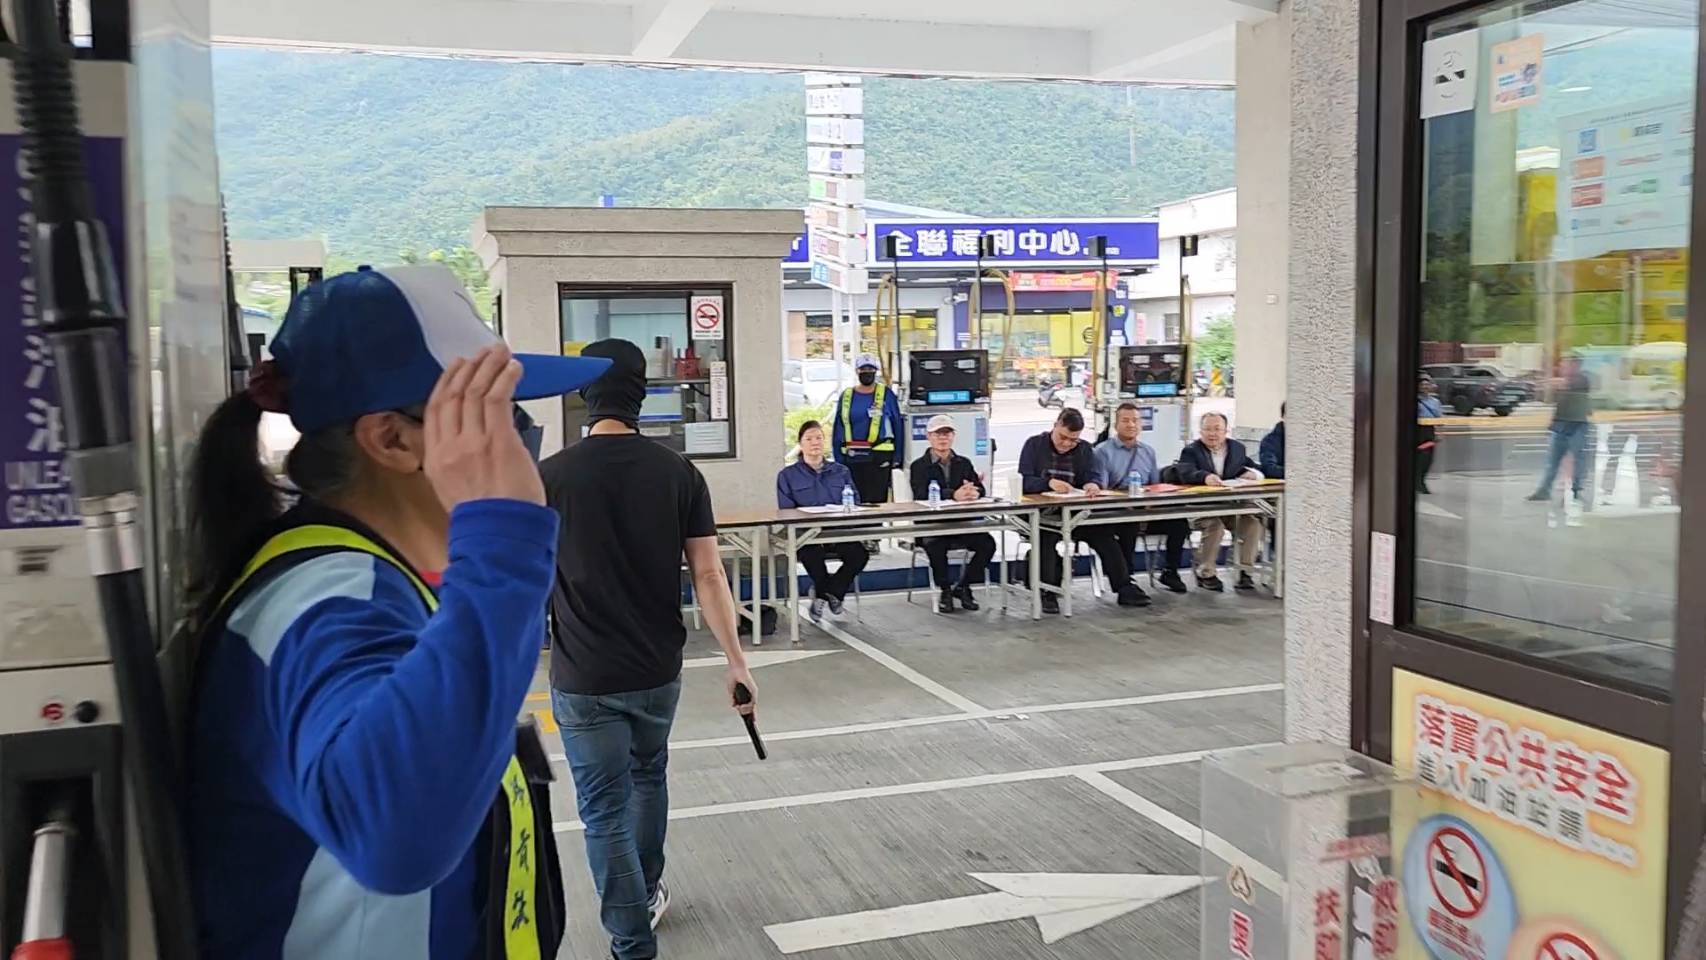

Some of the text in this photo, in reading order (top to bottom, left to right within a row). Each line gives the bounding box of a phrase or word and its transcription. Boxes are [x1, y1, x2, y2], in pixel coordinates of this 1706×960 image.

[889, 229, 1079, 257] 全聯福利中心
[1420, 703, 1630, 816] 落實公共安全
